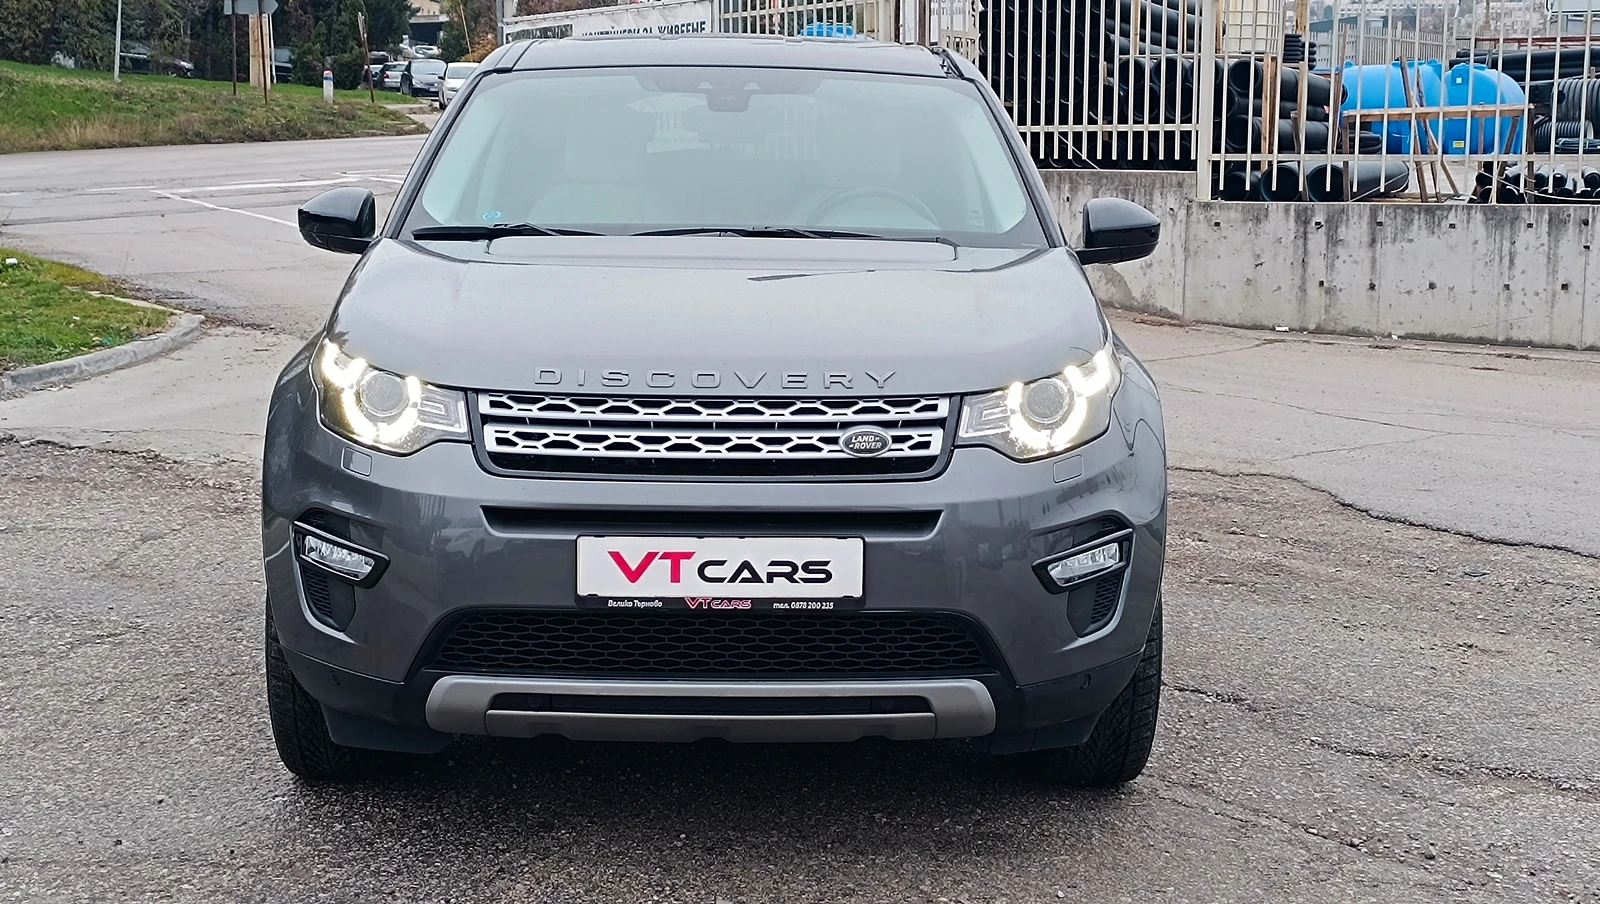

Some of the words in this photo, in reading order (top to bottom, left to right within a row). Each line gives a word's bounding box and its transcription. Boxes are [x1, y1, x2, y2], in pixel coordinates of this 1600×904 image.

[534, 367, 896, 390] DISCOVERY
[790, 601, 807, 609] 0878
[807, 601, 821, 609] 200
[821, 602, 834, 610] 235
